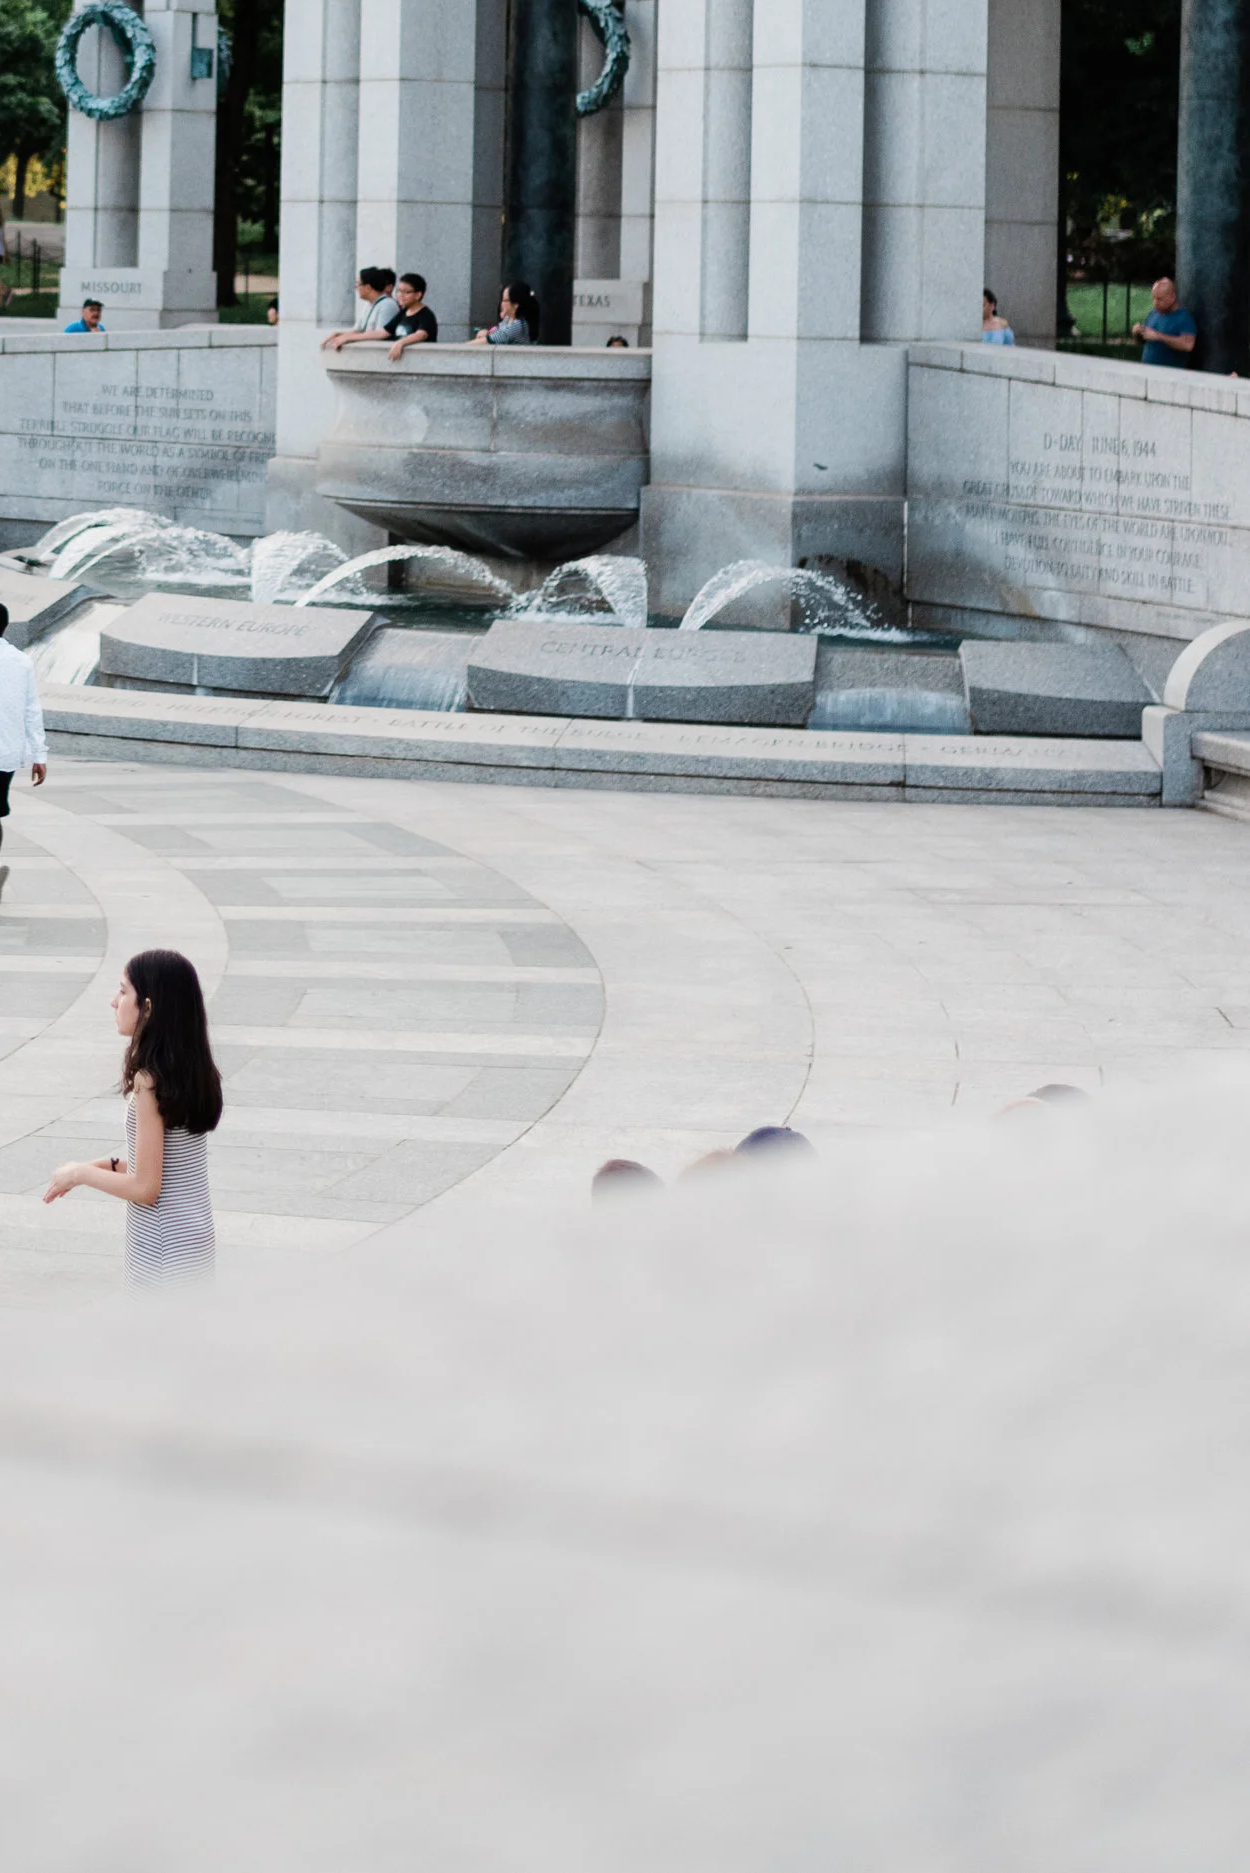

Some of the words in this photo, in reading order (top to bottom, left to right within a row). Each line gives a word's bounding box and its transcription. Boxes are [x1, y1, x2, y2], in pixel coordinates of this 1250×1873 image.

[80, 280, 142, 295] MISSOURI
[1043, 433, 1083, 452] D-DAY
[1133, 439, 1156, 458] 1944
[236, 620, 309, 639] EUROPE
